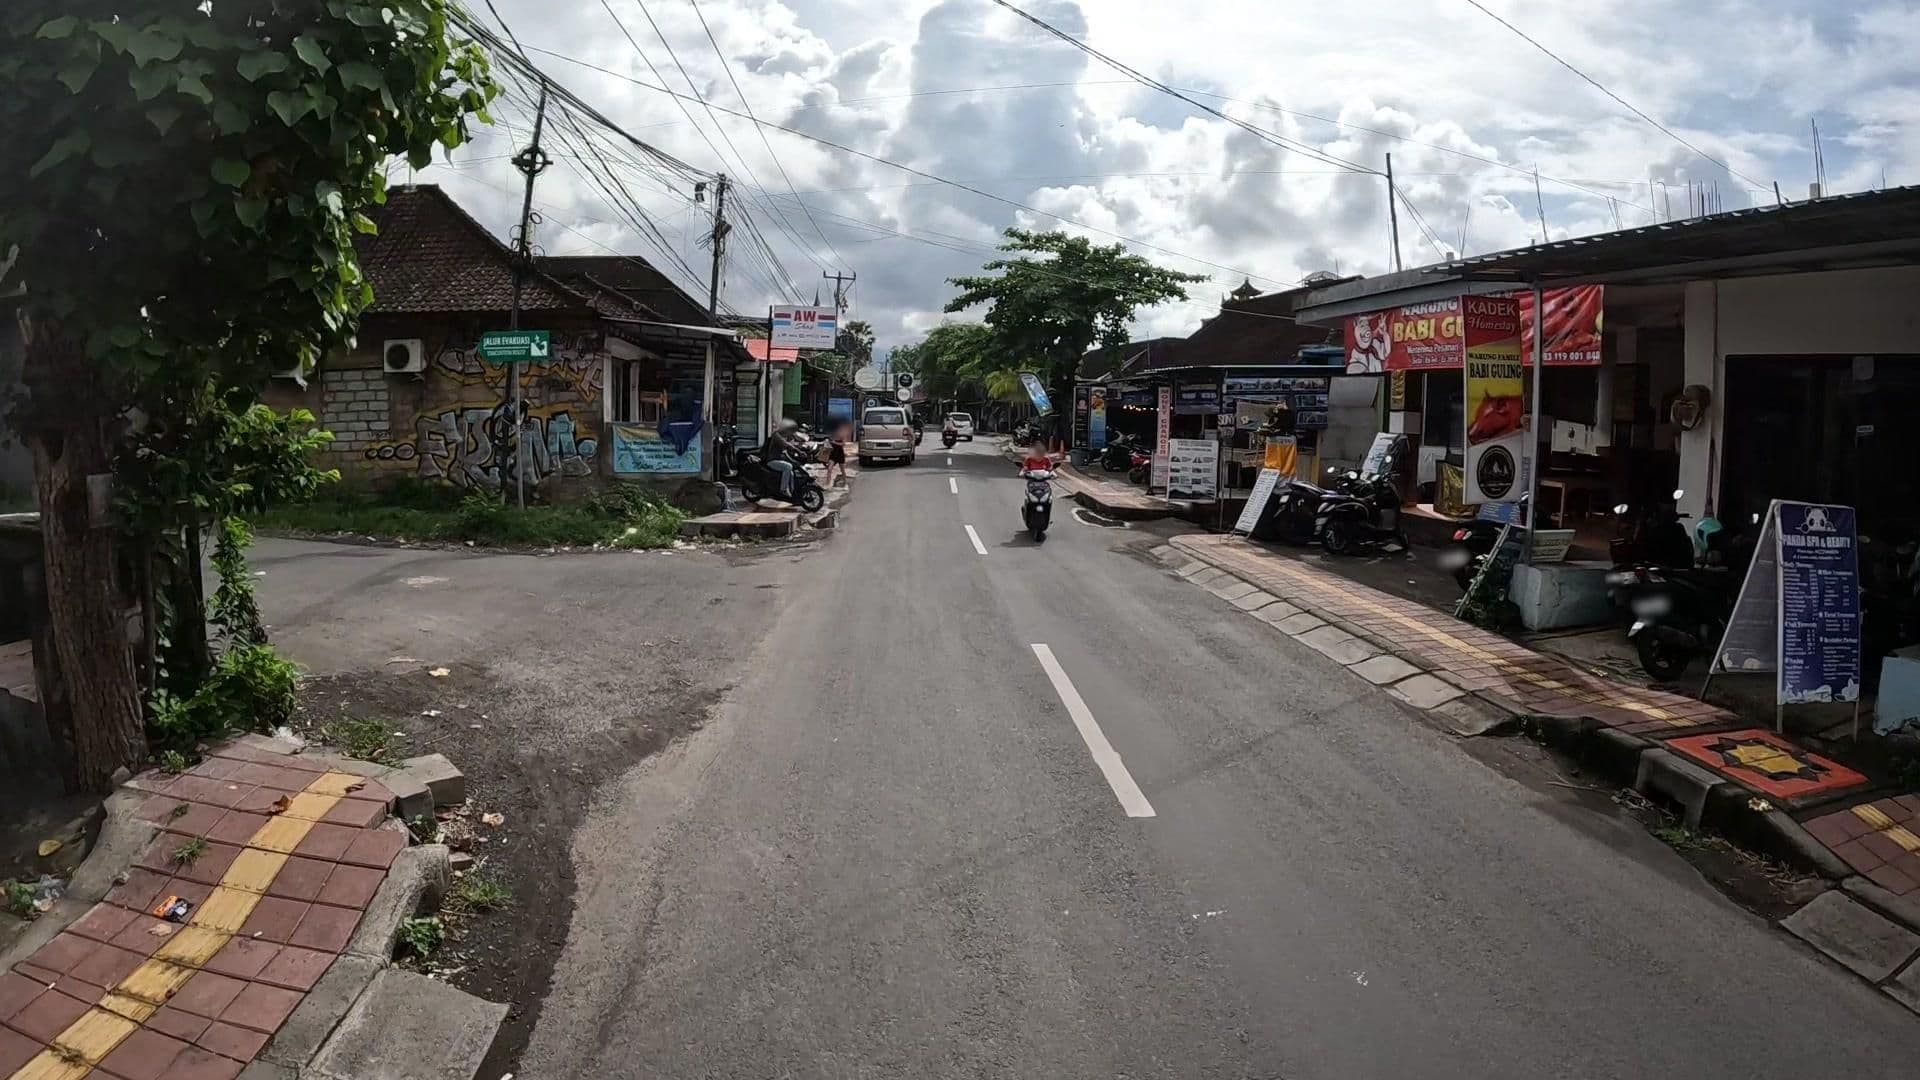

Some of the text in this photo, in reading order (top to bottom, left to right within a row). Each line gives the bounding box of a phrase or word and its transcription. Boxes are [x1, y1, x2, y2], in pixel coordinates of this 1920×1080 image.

[794, 310, 816, 322] AW
[1468, 301, 1516, 316] KADEK
[1393, 318, 1436, 342] BABI
[1468, 316, 1516, 334] Homestay
[1469, 362, 1522, 379] BABI GULING
[1806, 535, 1820, 548] SPA
[1826, 537, 1851, 549] BEAUTY
